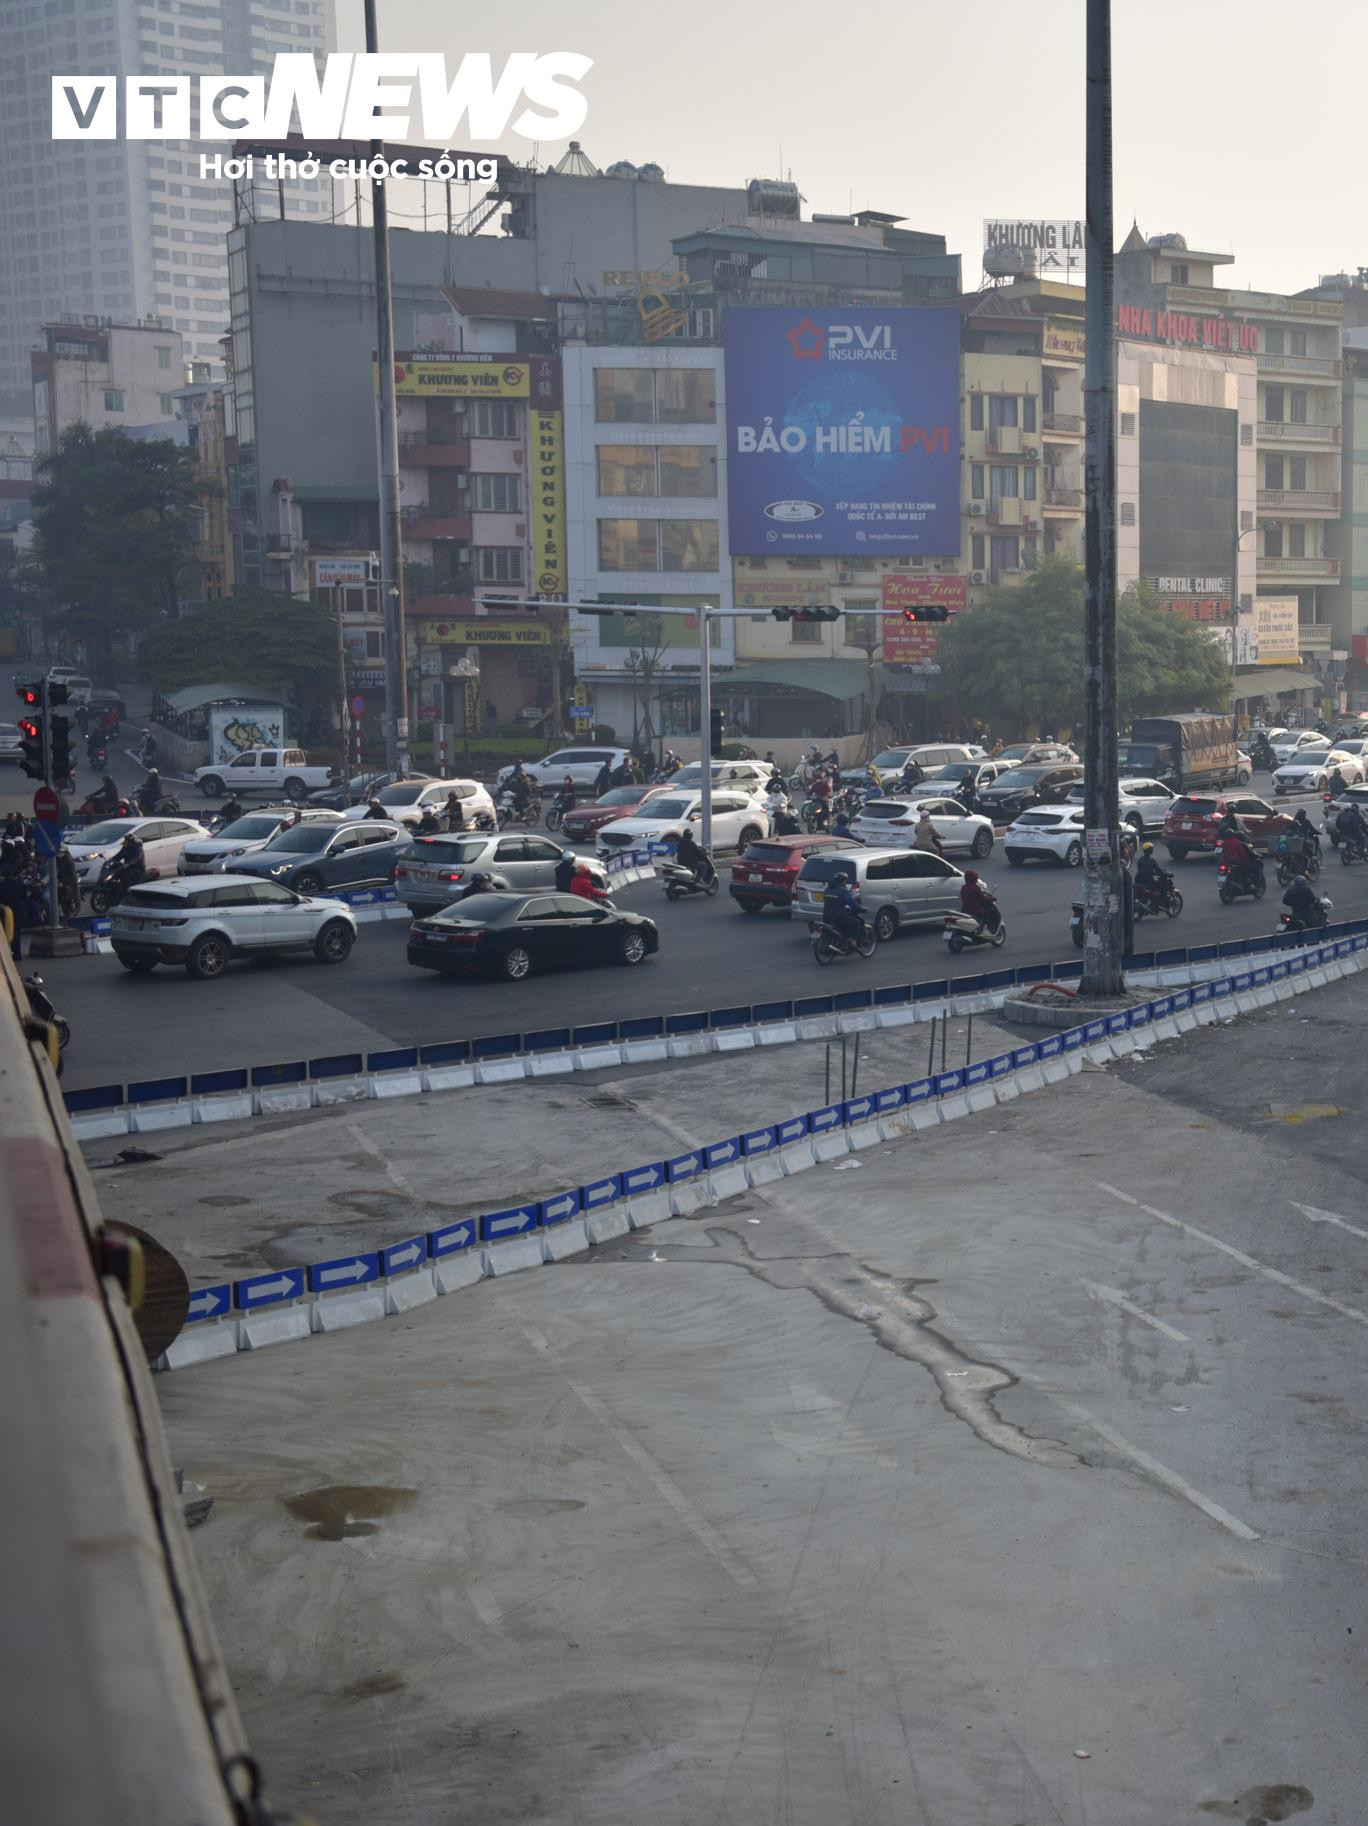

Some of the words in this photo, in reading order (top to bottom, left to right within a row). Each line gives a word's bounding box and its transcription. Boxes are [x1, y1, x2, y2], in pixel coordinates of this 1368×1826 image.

[987, 221, 1057, 249] KHƯƠNG
[1062, 220, 1086, 249] LÂ
[828, 325, 891, 349] PVI
[1117, 303, 1152, 336] NHA
[1156, 309, 1198, 343] KHOA
[1202, 312, 1236, 351] VIỆT
[828, 349, 898, 361] INSURANCE
[418, 373, 468, 386] KHƯƠNG
[471, 371, 499, 387] VIÊN
[737, 416, 807, 453] BẢO
[816, 411, 891, 453] HIỂM
[901, 426, 950, 453] PVI
[1158, 576, 1193, 593] DENTAL
[1194, 576, 1224, 593] CLINIC
[466, 630, 512, 641] KHƯƠNG
[515, 629, 541, 641] VIÊN
